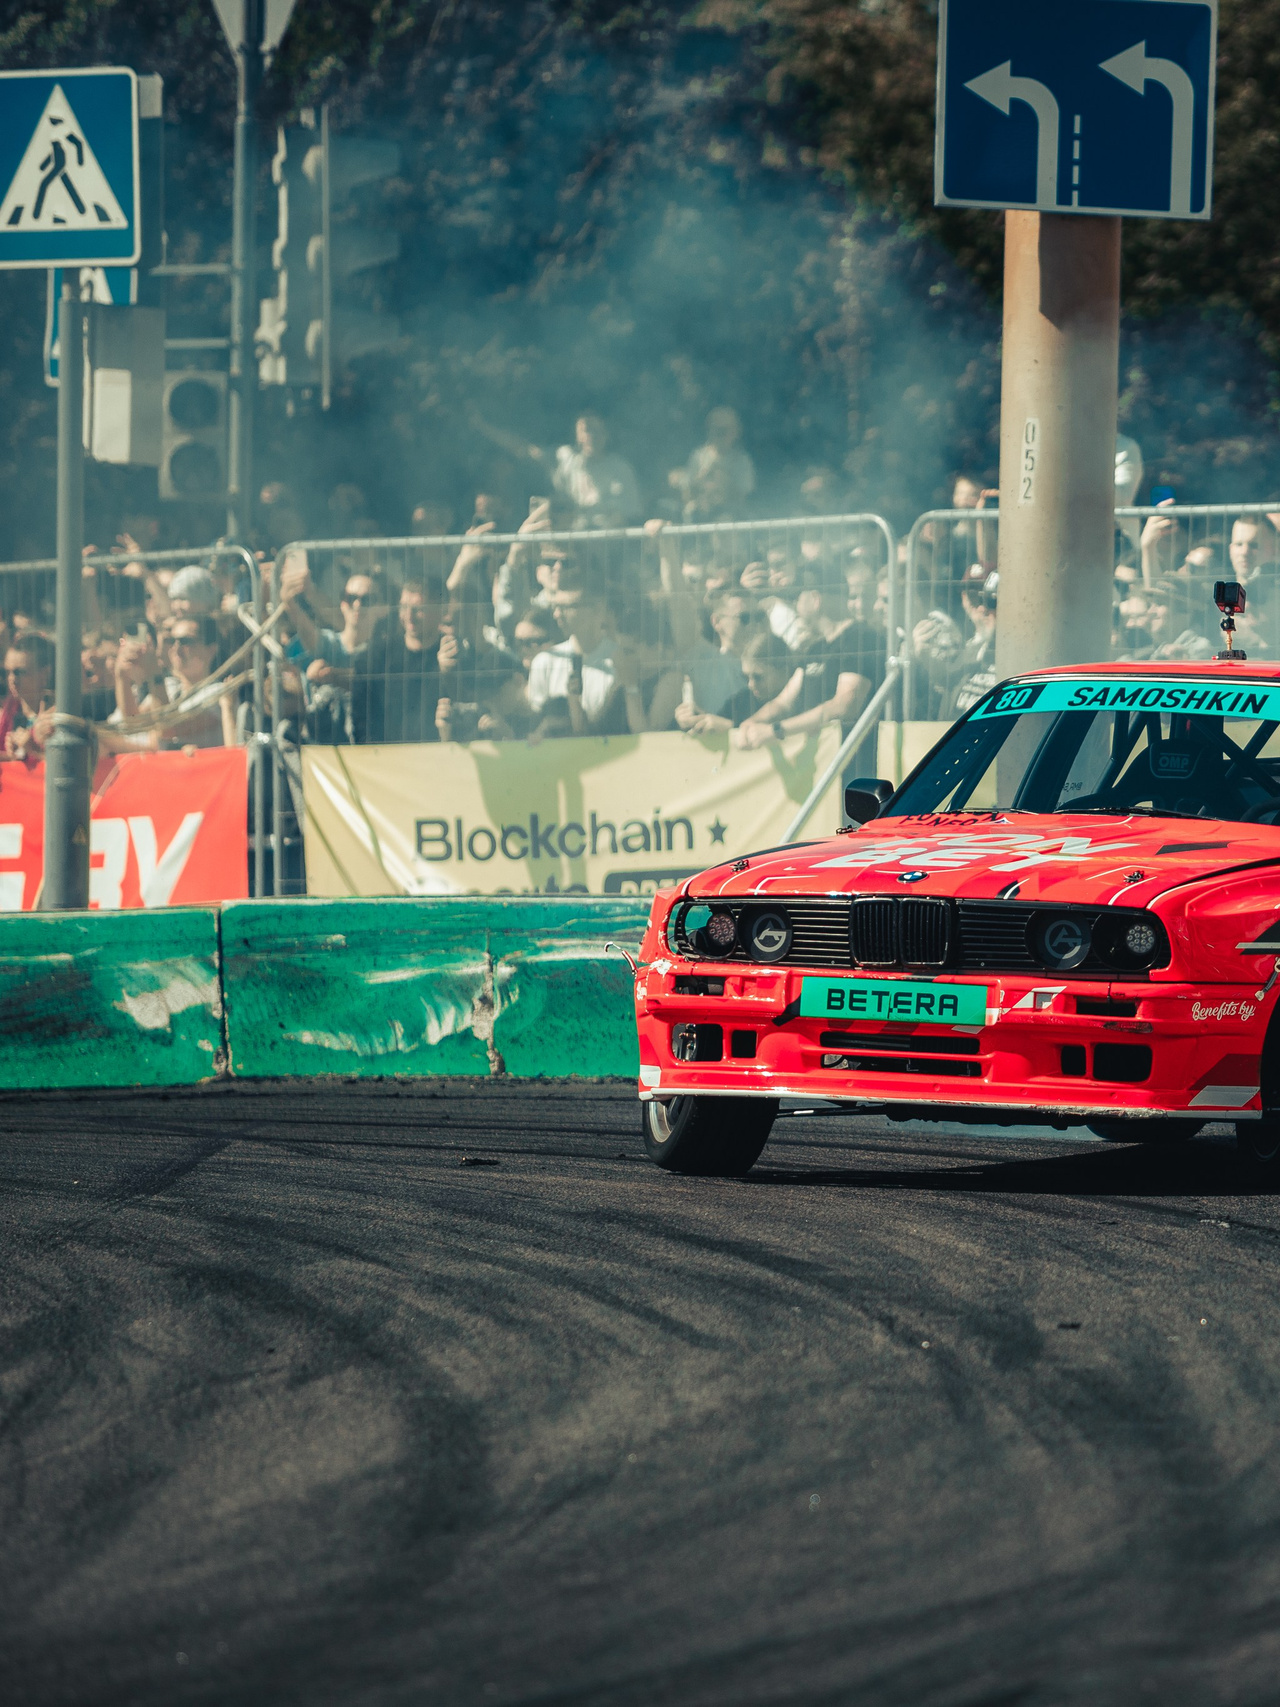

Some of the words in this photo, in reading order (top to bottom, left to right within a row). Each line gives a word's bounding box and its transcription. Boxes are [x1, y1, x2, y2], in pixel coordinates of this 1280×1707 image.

[1023, 421, 1036, 499] 052
[995, 688, 1029, 711] 80
[1067, 686, 1270, 714] SAMOSHKIN
[1158, 755, 1189, 769] OMP
[415, 808, 694, 862] Blockchain
[1191, 1001, 1240, 1021] Benefits
[1238, 1000, 1257, 1021] by
